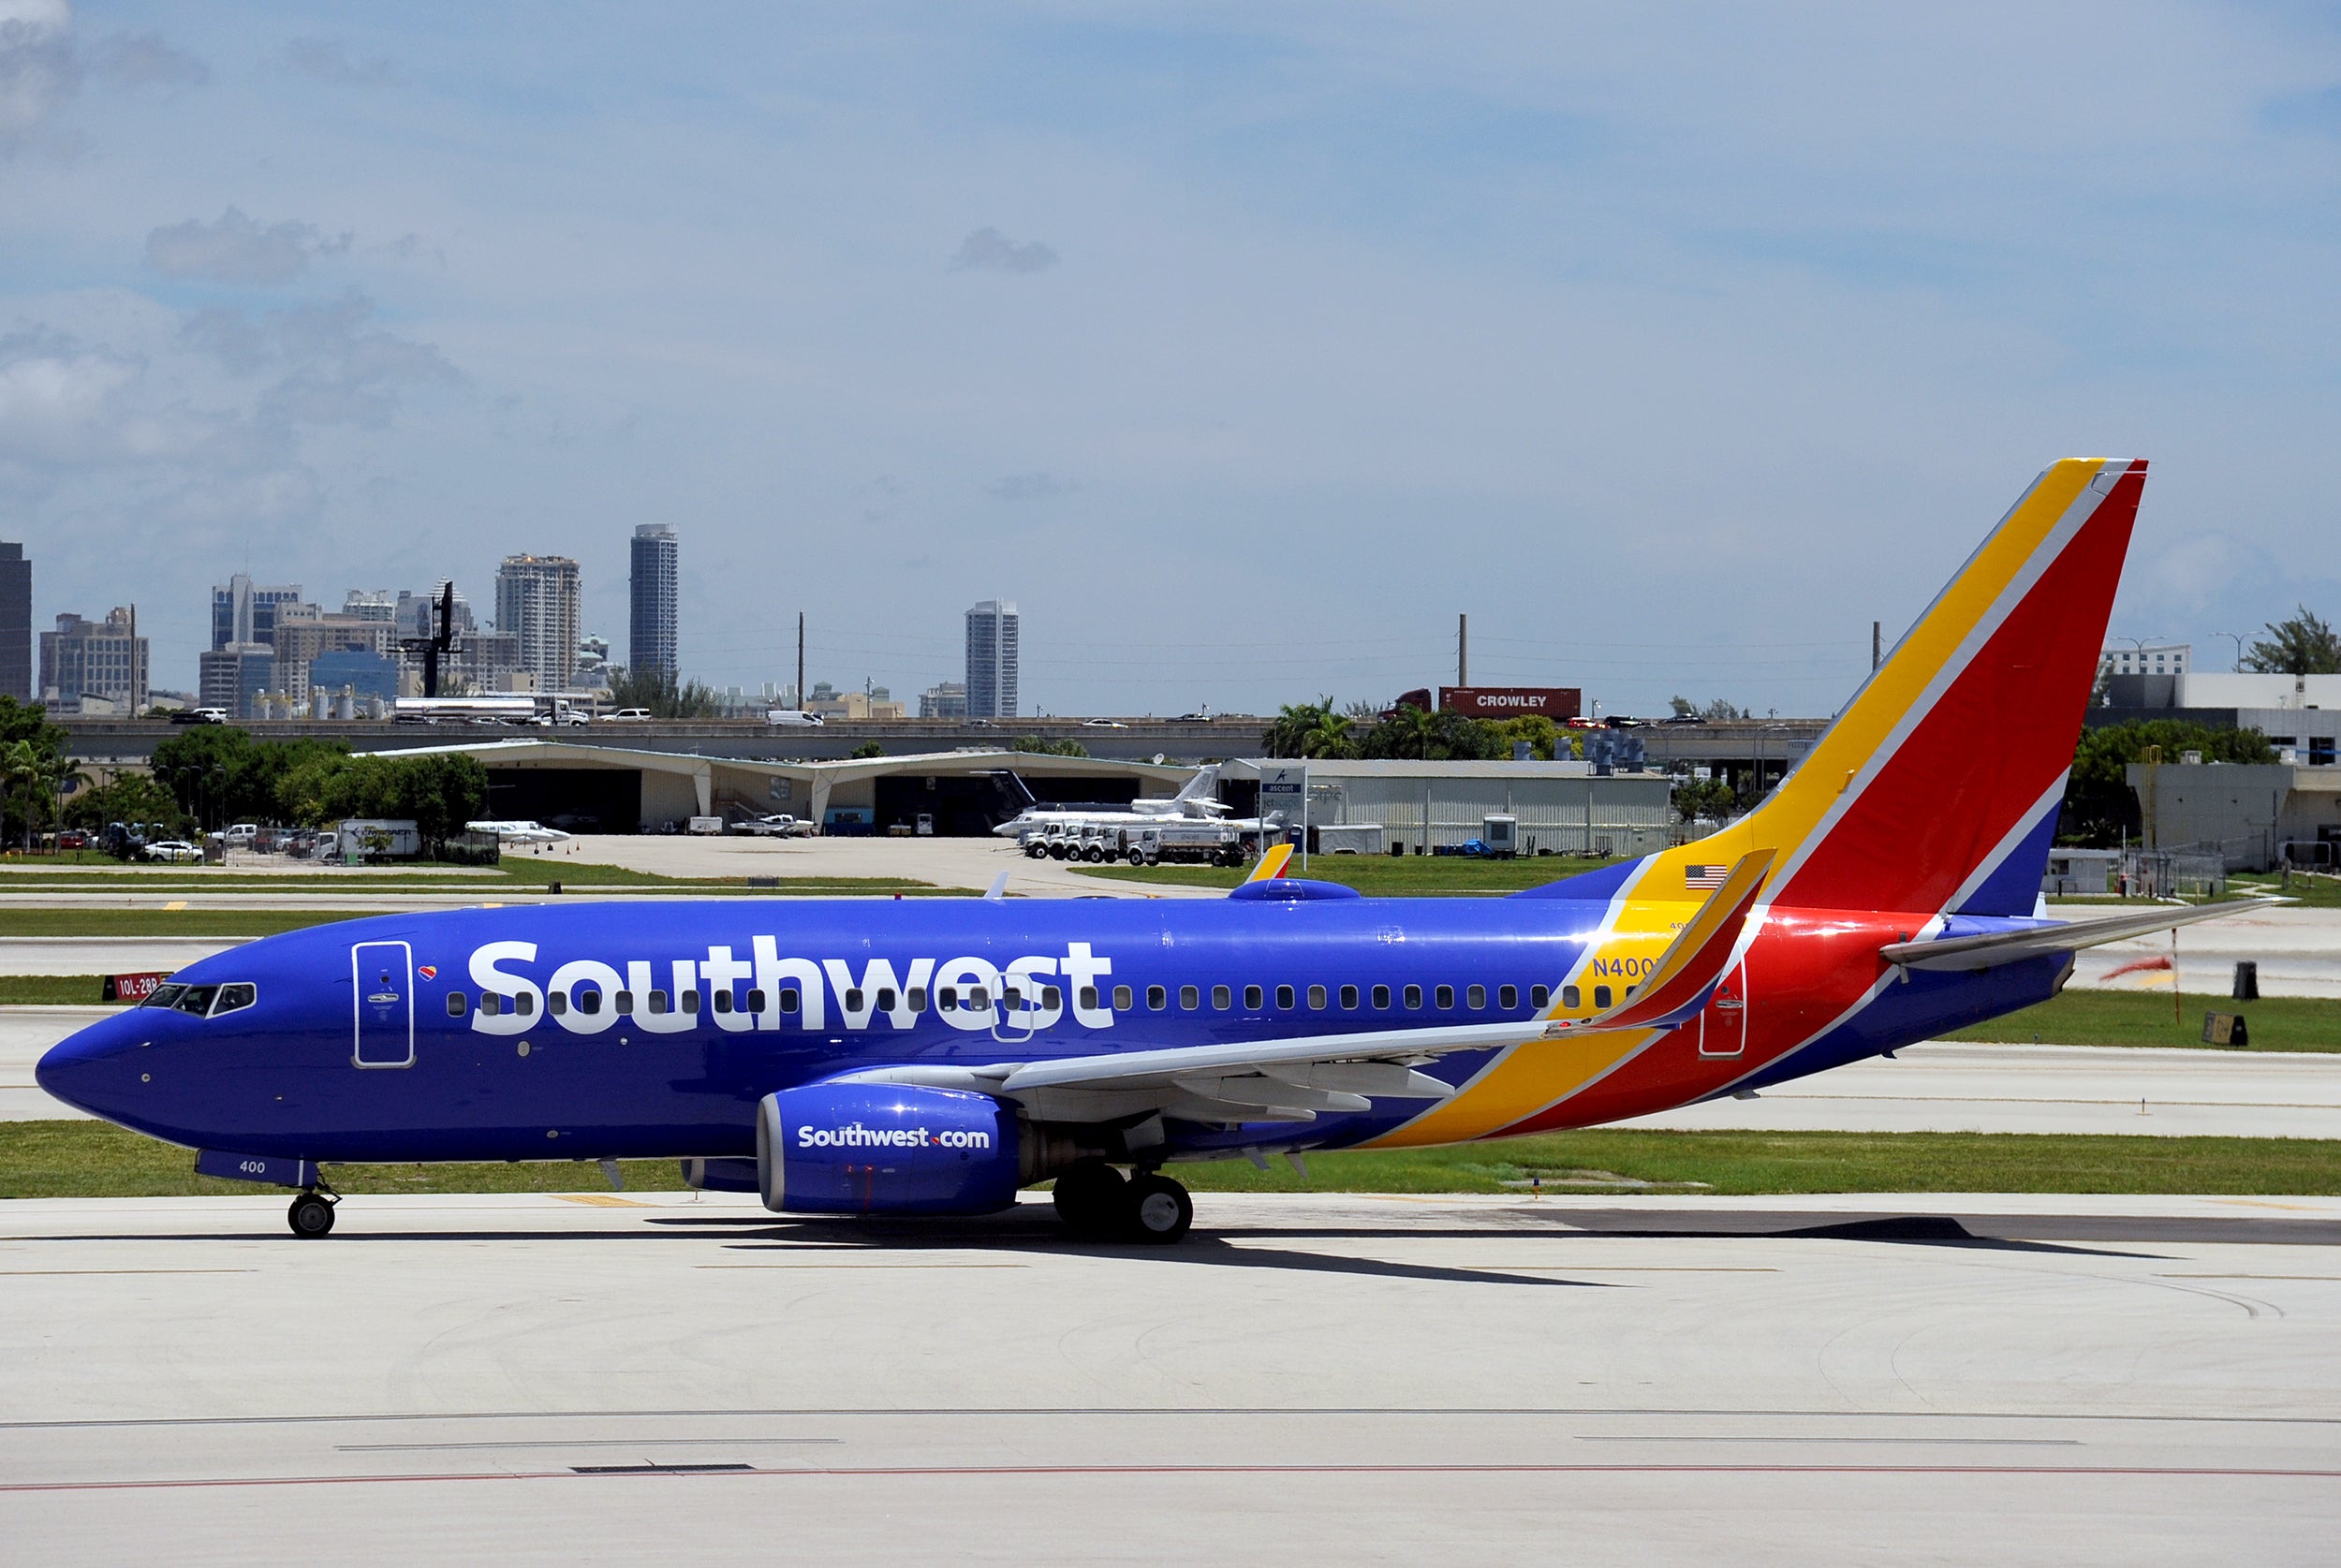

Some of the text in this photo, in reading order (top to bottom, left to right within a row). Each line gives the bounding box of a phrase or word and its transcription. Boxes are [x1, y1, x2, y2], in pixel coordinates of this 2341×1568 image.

[1477, 696, 1547, 707] CROWLEY
[469, 935, 1113, 1034] Southwest
[240, 1161, 265, 1174] 400
